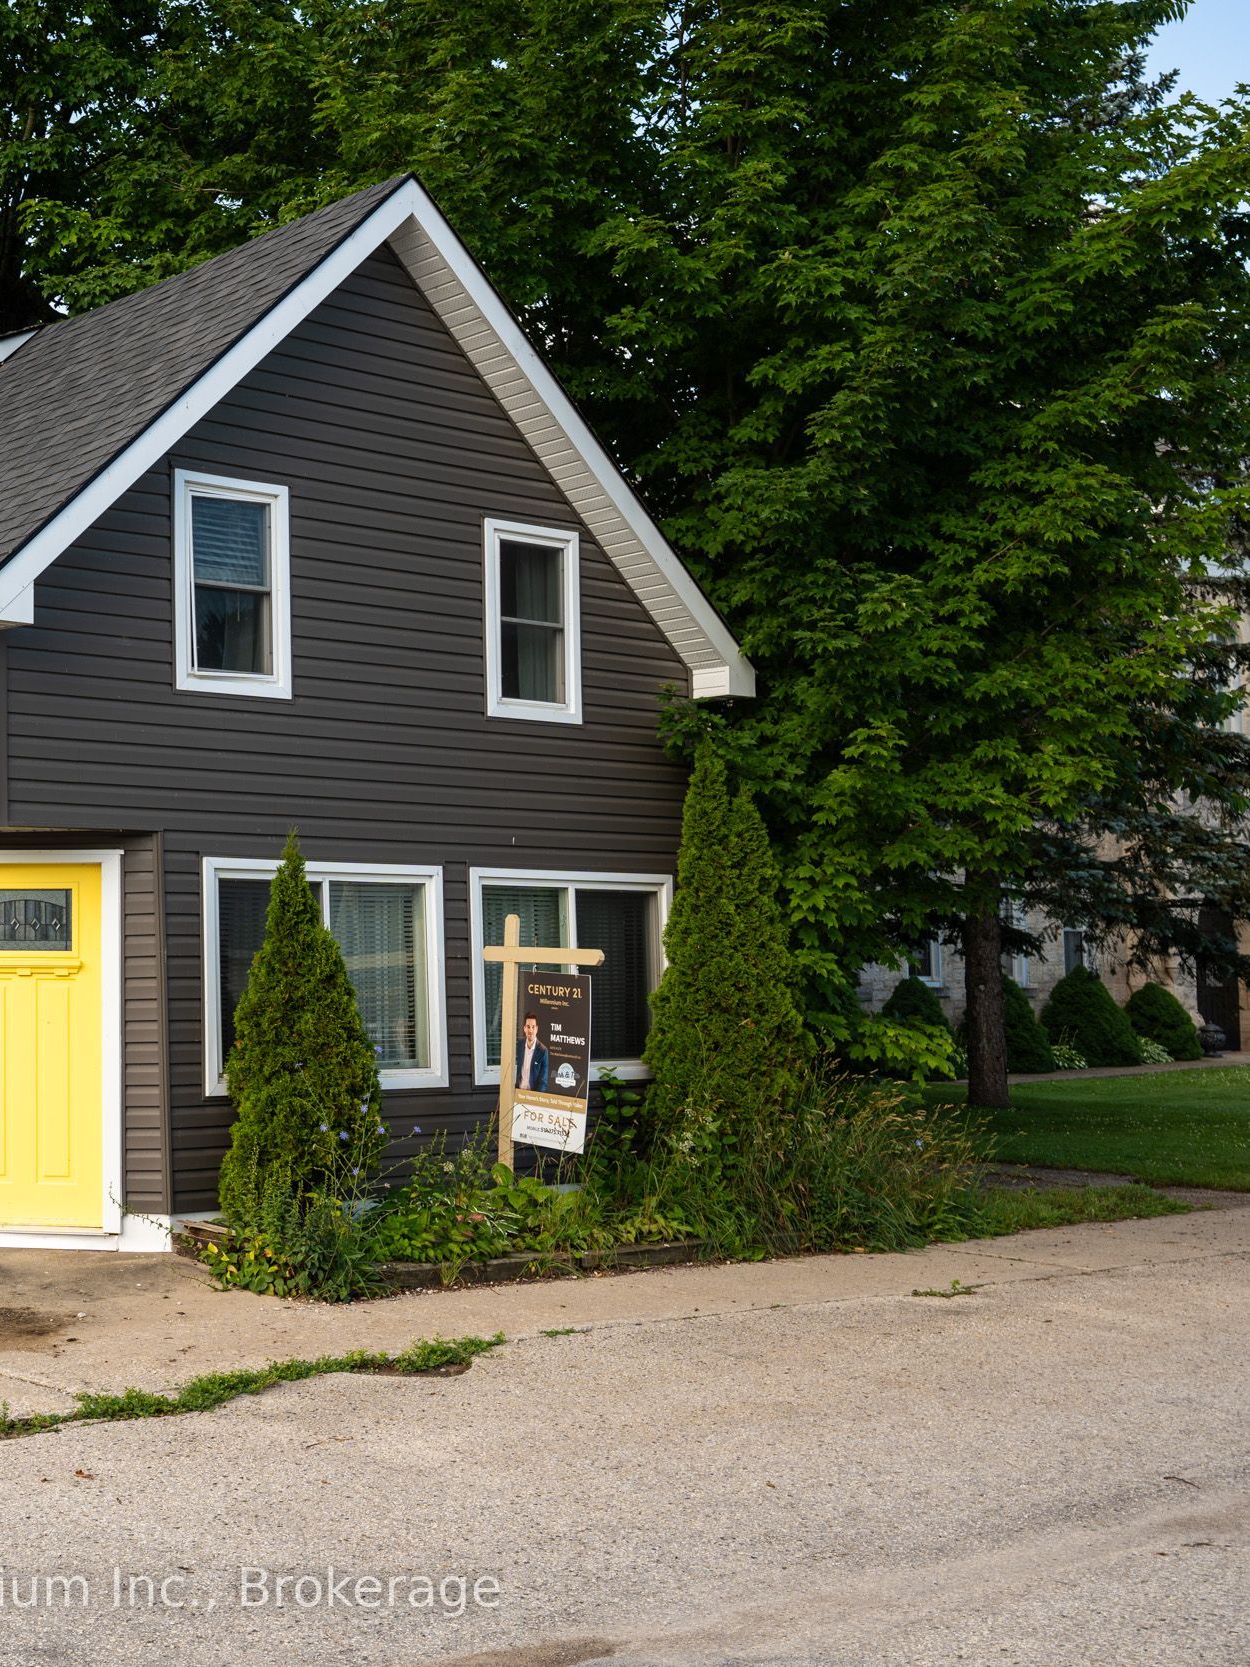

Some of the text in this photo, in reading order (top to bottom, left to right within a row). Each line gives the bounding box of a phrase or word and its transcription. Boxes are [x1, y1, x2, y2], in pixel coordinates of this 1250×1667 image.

[528, 984, 582, 998] CENTURY 21
[551, 1023, 561, 1031] TIM
[550, 1034, 585, 1045] MATTHEWS
[524, 1111, 575, 1129] FOR SALE
